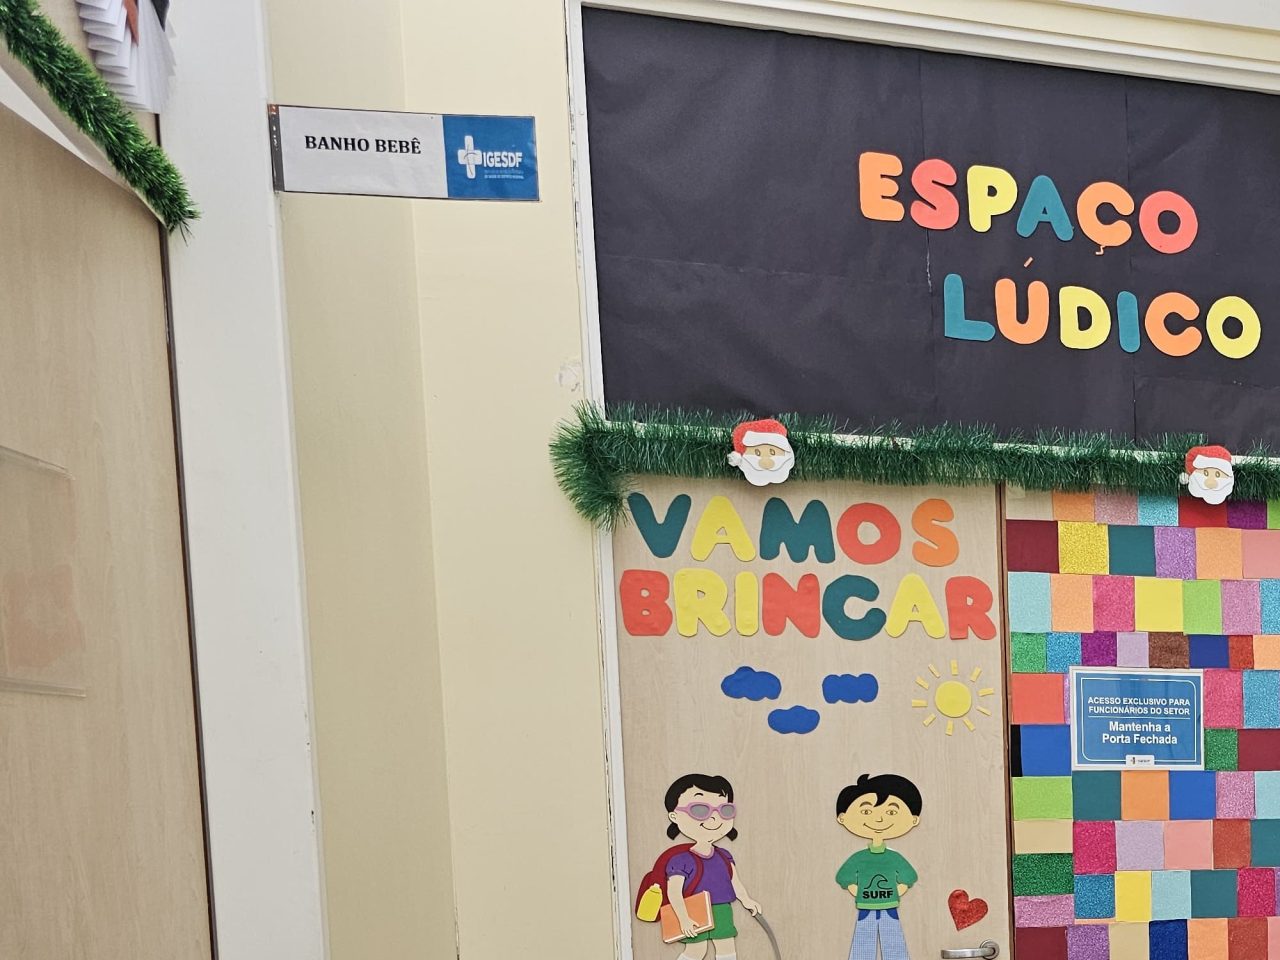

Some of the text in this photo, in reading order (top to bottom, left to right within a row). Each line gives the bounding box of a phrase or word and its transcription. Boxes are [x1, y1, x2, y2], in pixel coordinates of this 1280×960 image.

[304, 135, 422, 155] BANHO BEBÊ
[482, 151, 523, 168] IGESDF
[859, 152, 1198, 254] ESPAÇO
[943, 257, 1261, 359] LÚDICO
[627, 492, 960, 568] VAMOS
[619, 568, 997, 642] BRINCAR
[1088, 696, 1191, 706] ACESSO EXCLUSIVO PARA
[1088, 705, 1190, 715] FUNCIONÁRIOS DO SETOR
[1109, 721, 1171, 732] Mantenha a
[1102, 733, 1178, 744] Porta Fechada
[862, 890, 894, 899] SURF
